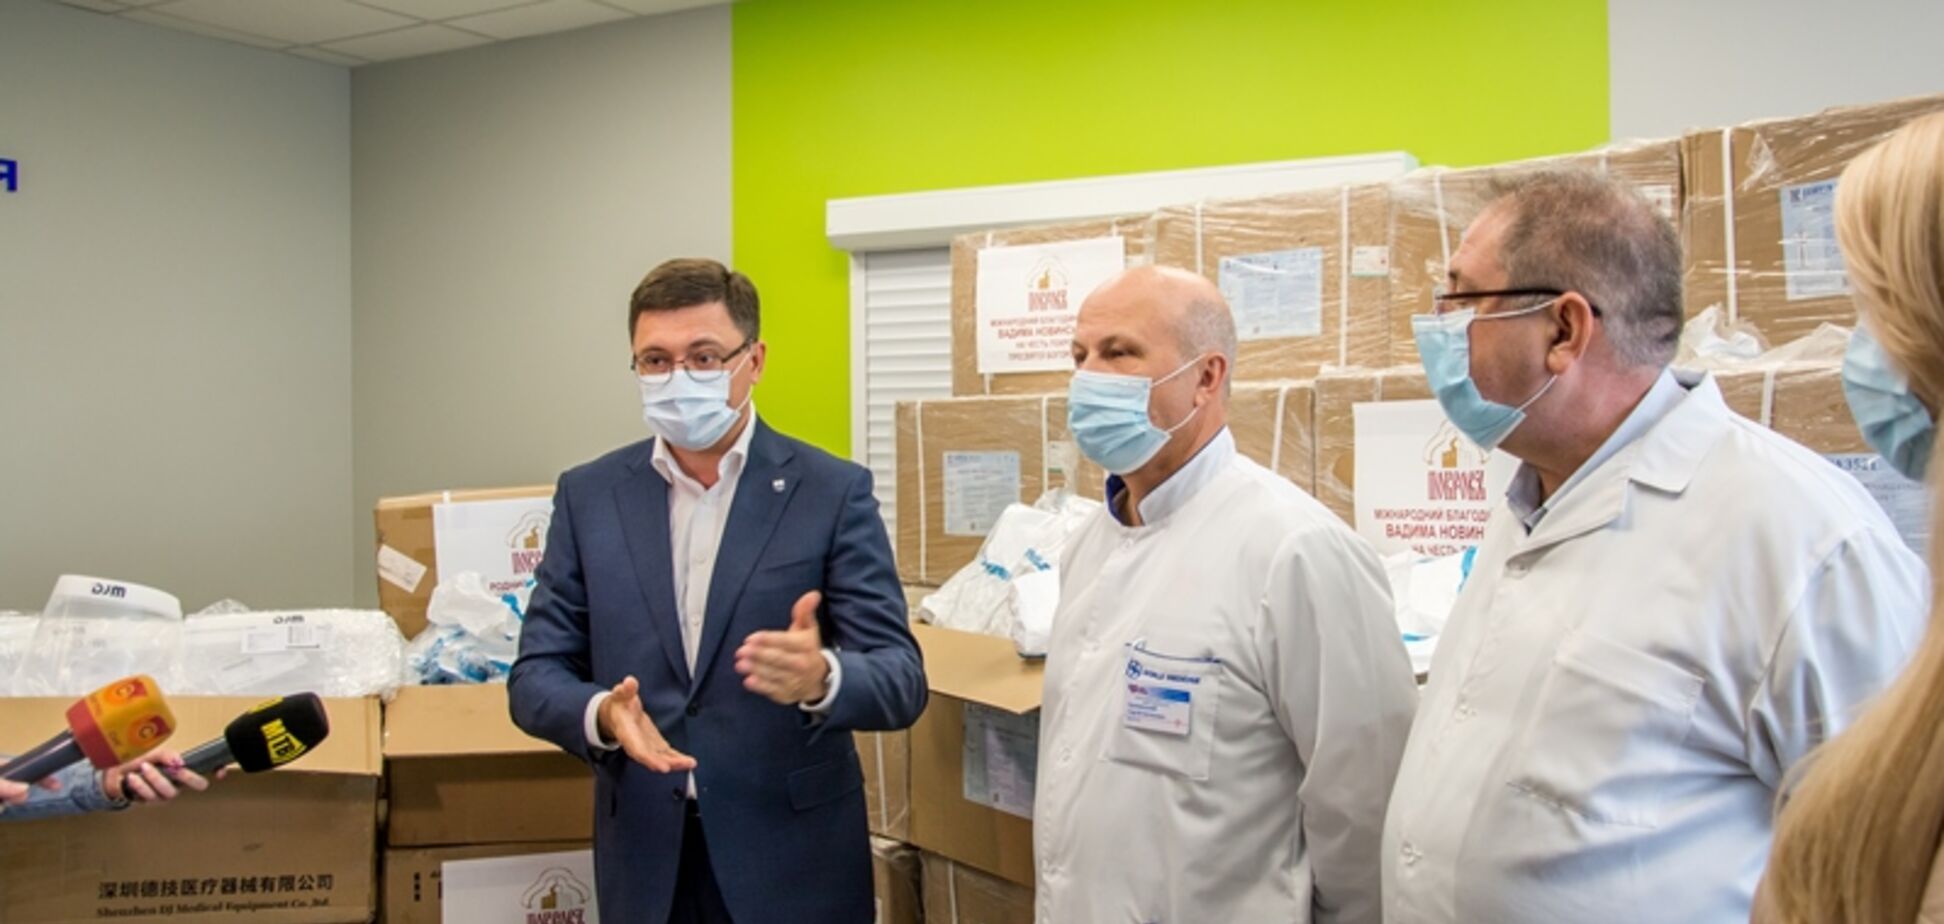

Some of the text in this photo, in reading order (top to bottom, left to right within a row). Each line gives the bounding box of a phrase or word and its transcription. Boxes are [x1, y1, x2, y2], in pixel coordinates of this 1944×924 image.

[1385, 523, 1485, 540] ВАДИМА НОВИН
[98, 874, 332, 899] 深圳德技医疗器械有限公司
[175, 901, 222, 913] Medical
